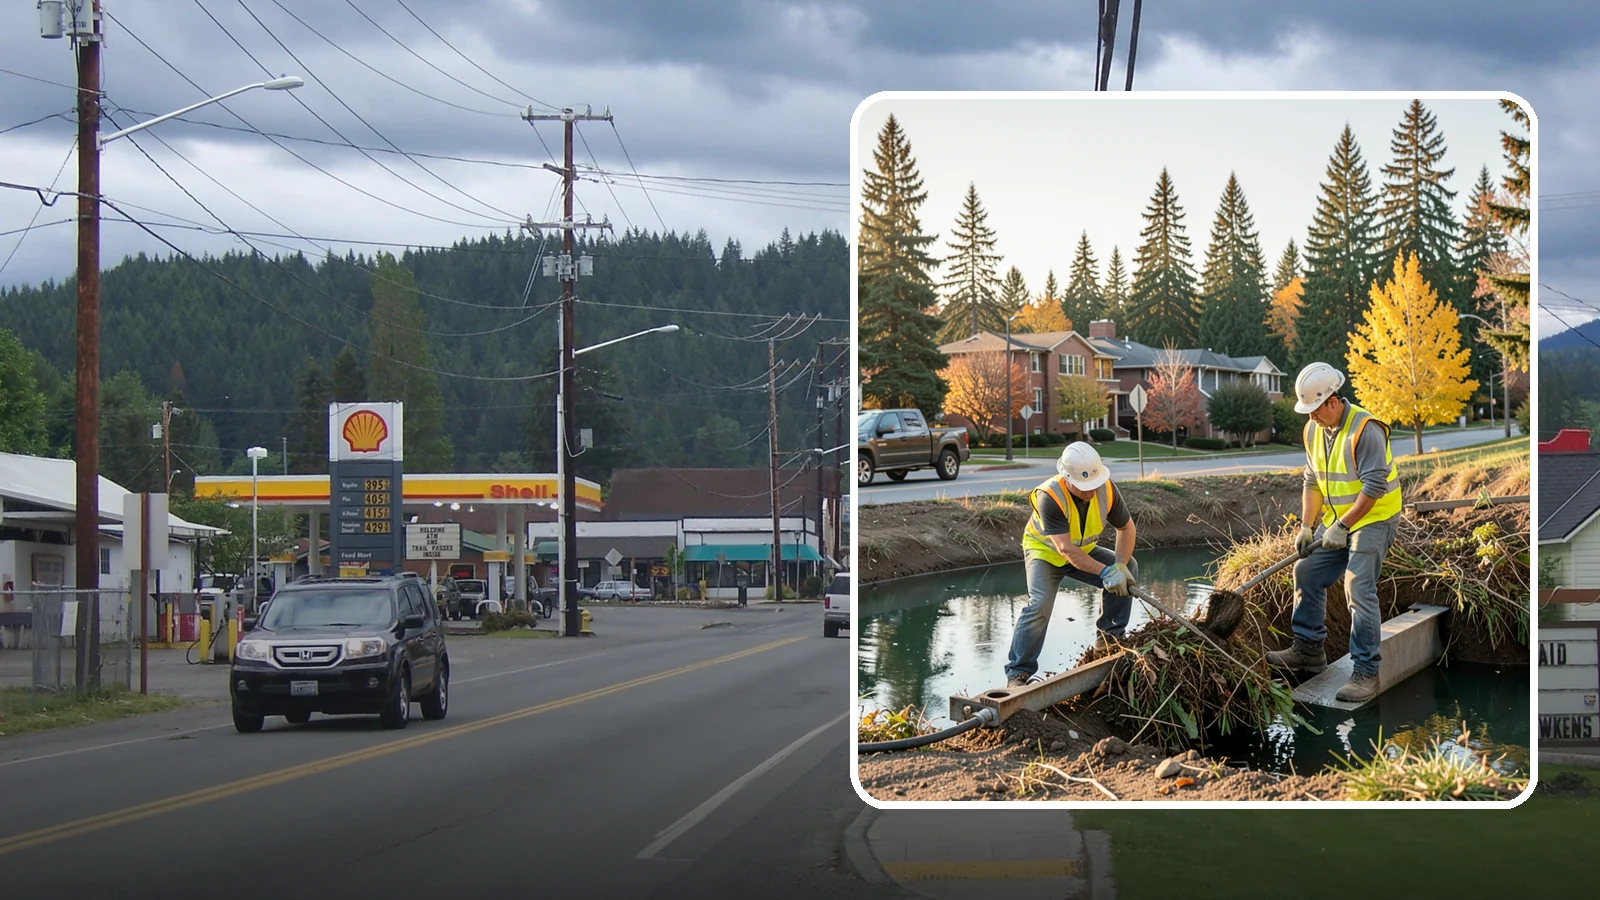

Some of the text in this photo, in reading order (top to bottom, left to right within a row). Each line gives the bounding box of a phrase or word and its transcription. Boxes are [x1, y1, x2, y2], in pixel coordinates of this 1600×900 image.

[366, 480, 383, 490] 395
[489, 484, 547, 499] Shell
[366, 494, 383, 504] 405
[366, 508, 383, 518] 415
[366, 522, 383, 532] 429
